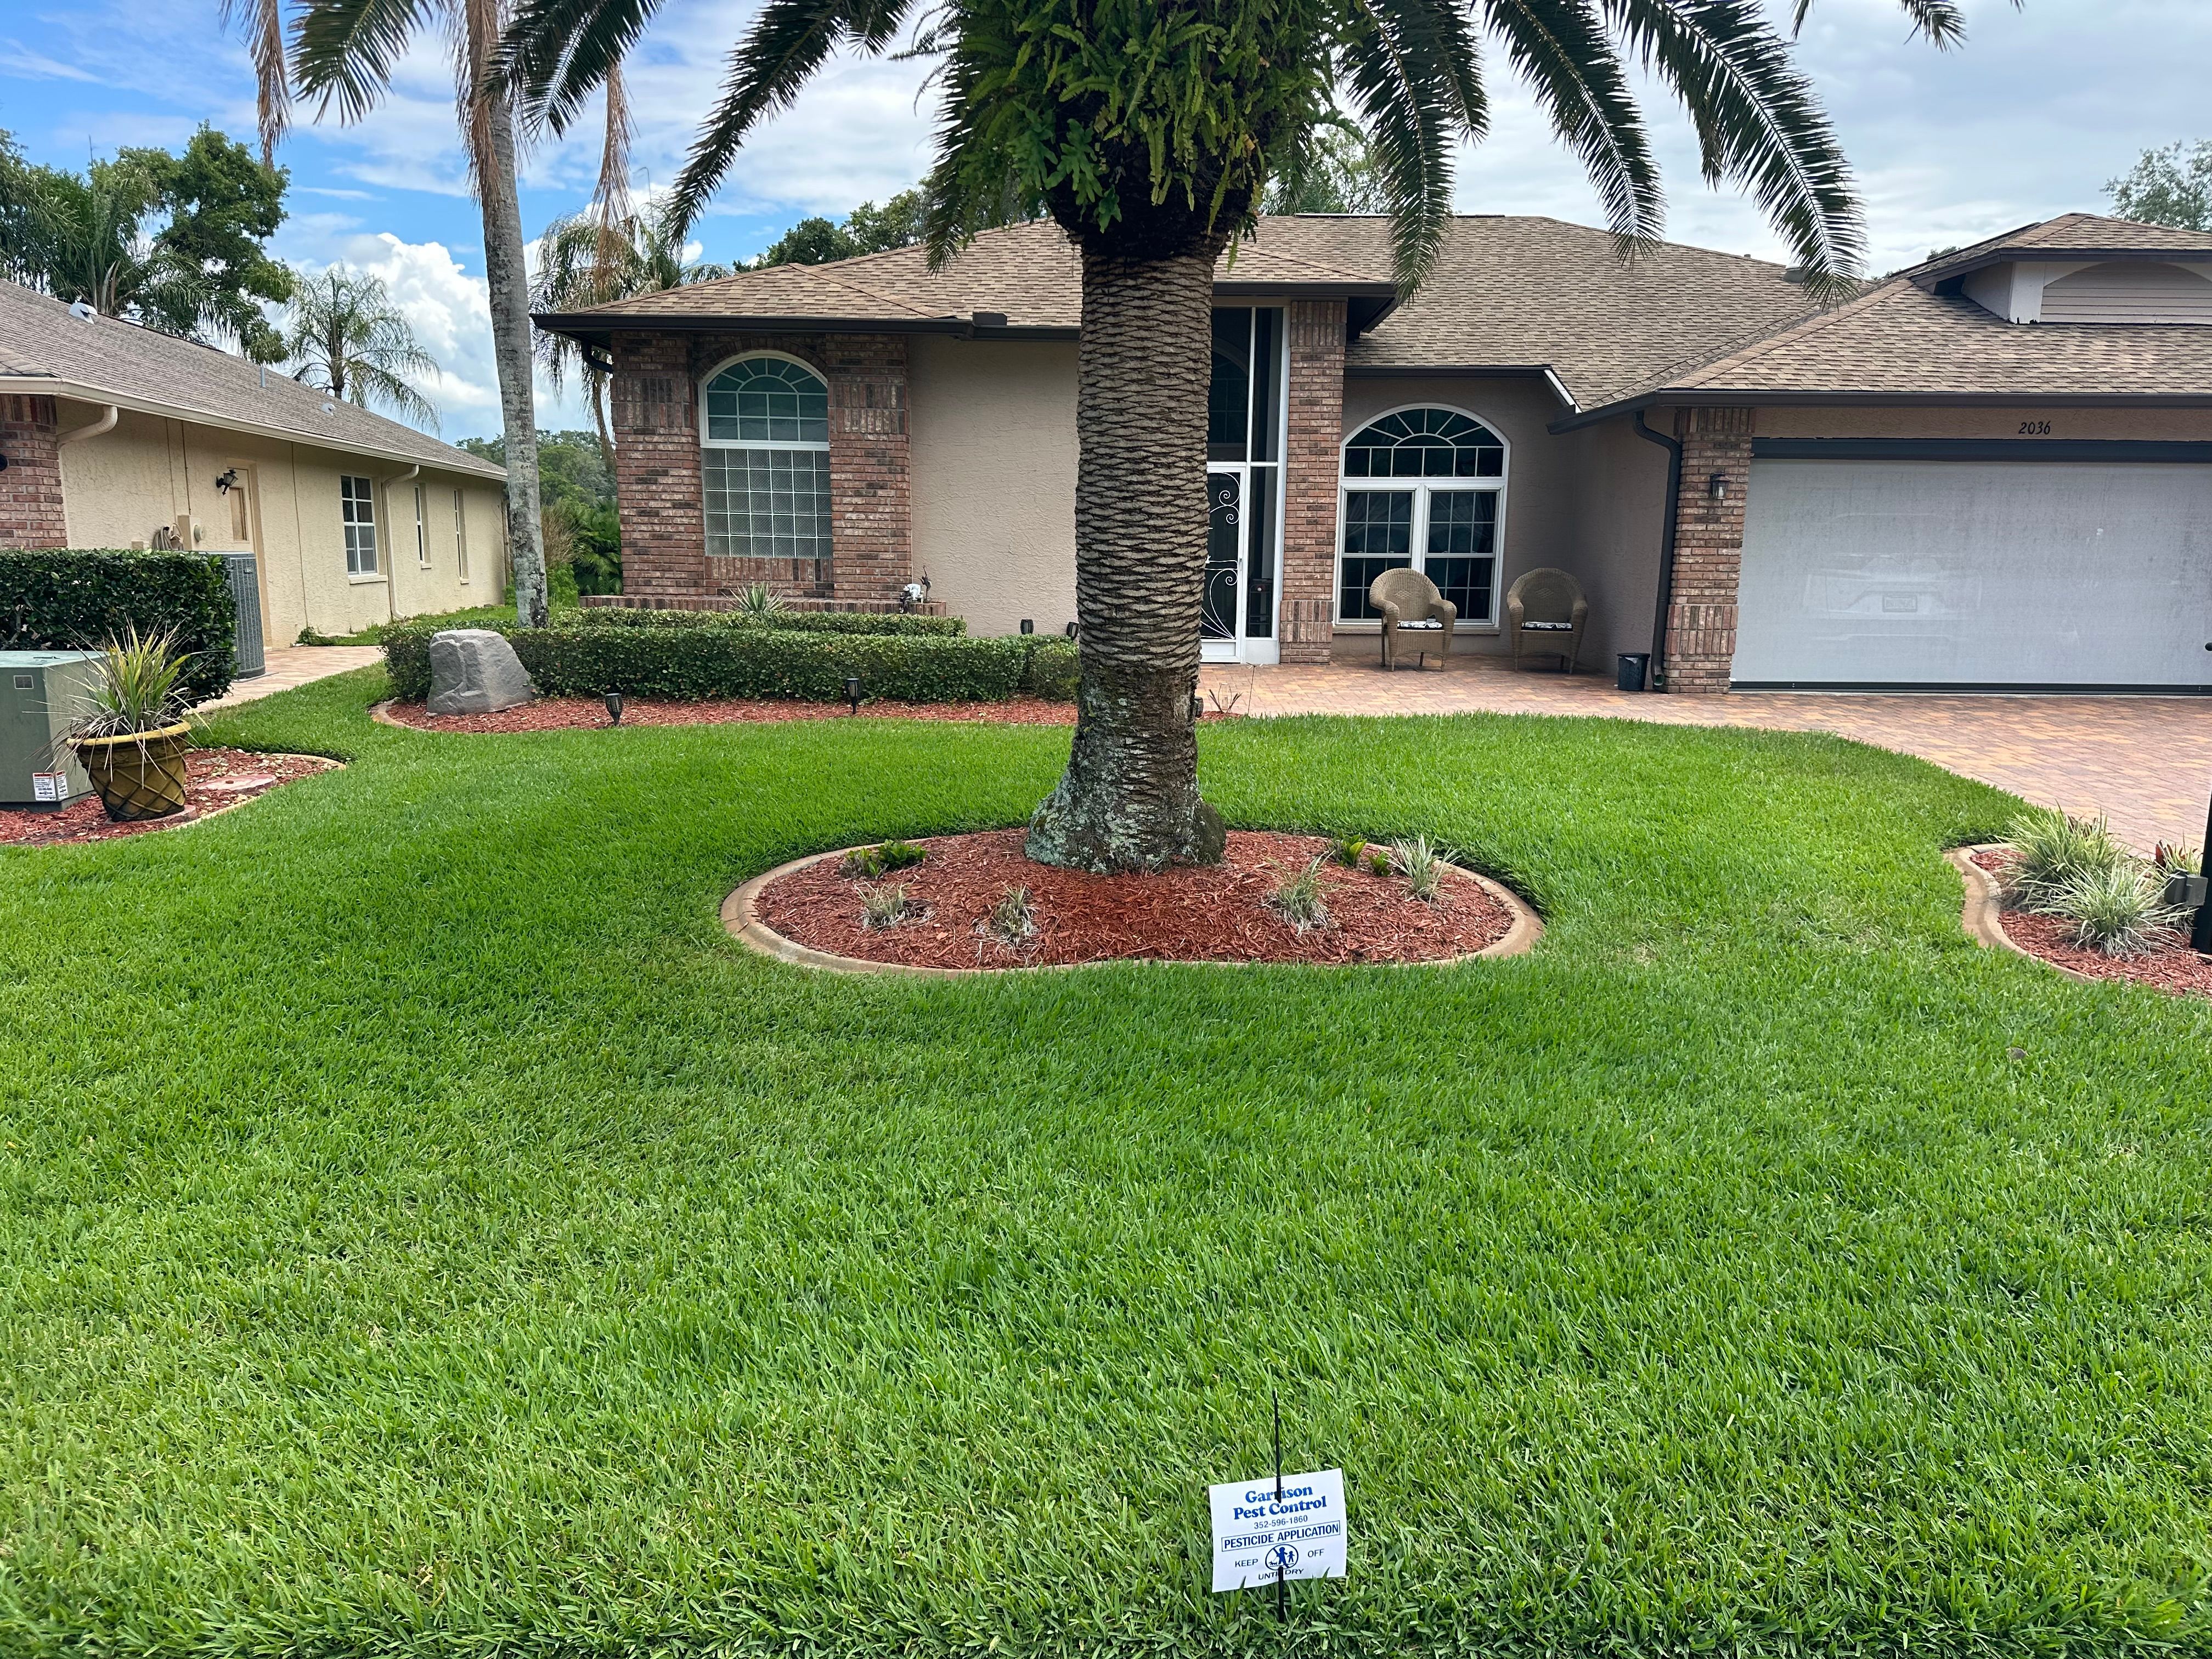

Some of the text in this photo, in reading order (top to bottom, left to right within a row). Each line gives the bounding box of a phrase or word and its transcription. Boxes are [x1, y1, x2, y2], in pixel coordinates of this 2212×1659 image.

[2018, 420, 2051, 435] 2036
[1233, 1496, 1327, 1520] Pest Control
[1254, 1515, 1308, 1529] 352-596-1860
[1224, 1523, 1339, 1549] PESTICIDE APPLICATION
[1235, 1549, 1324, 1567] KEEP OFF
[1258, 1571, 1279, 1580] UNTI
